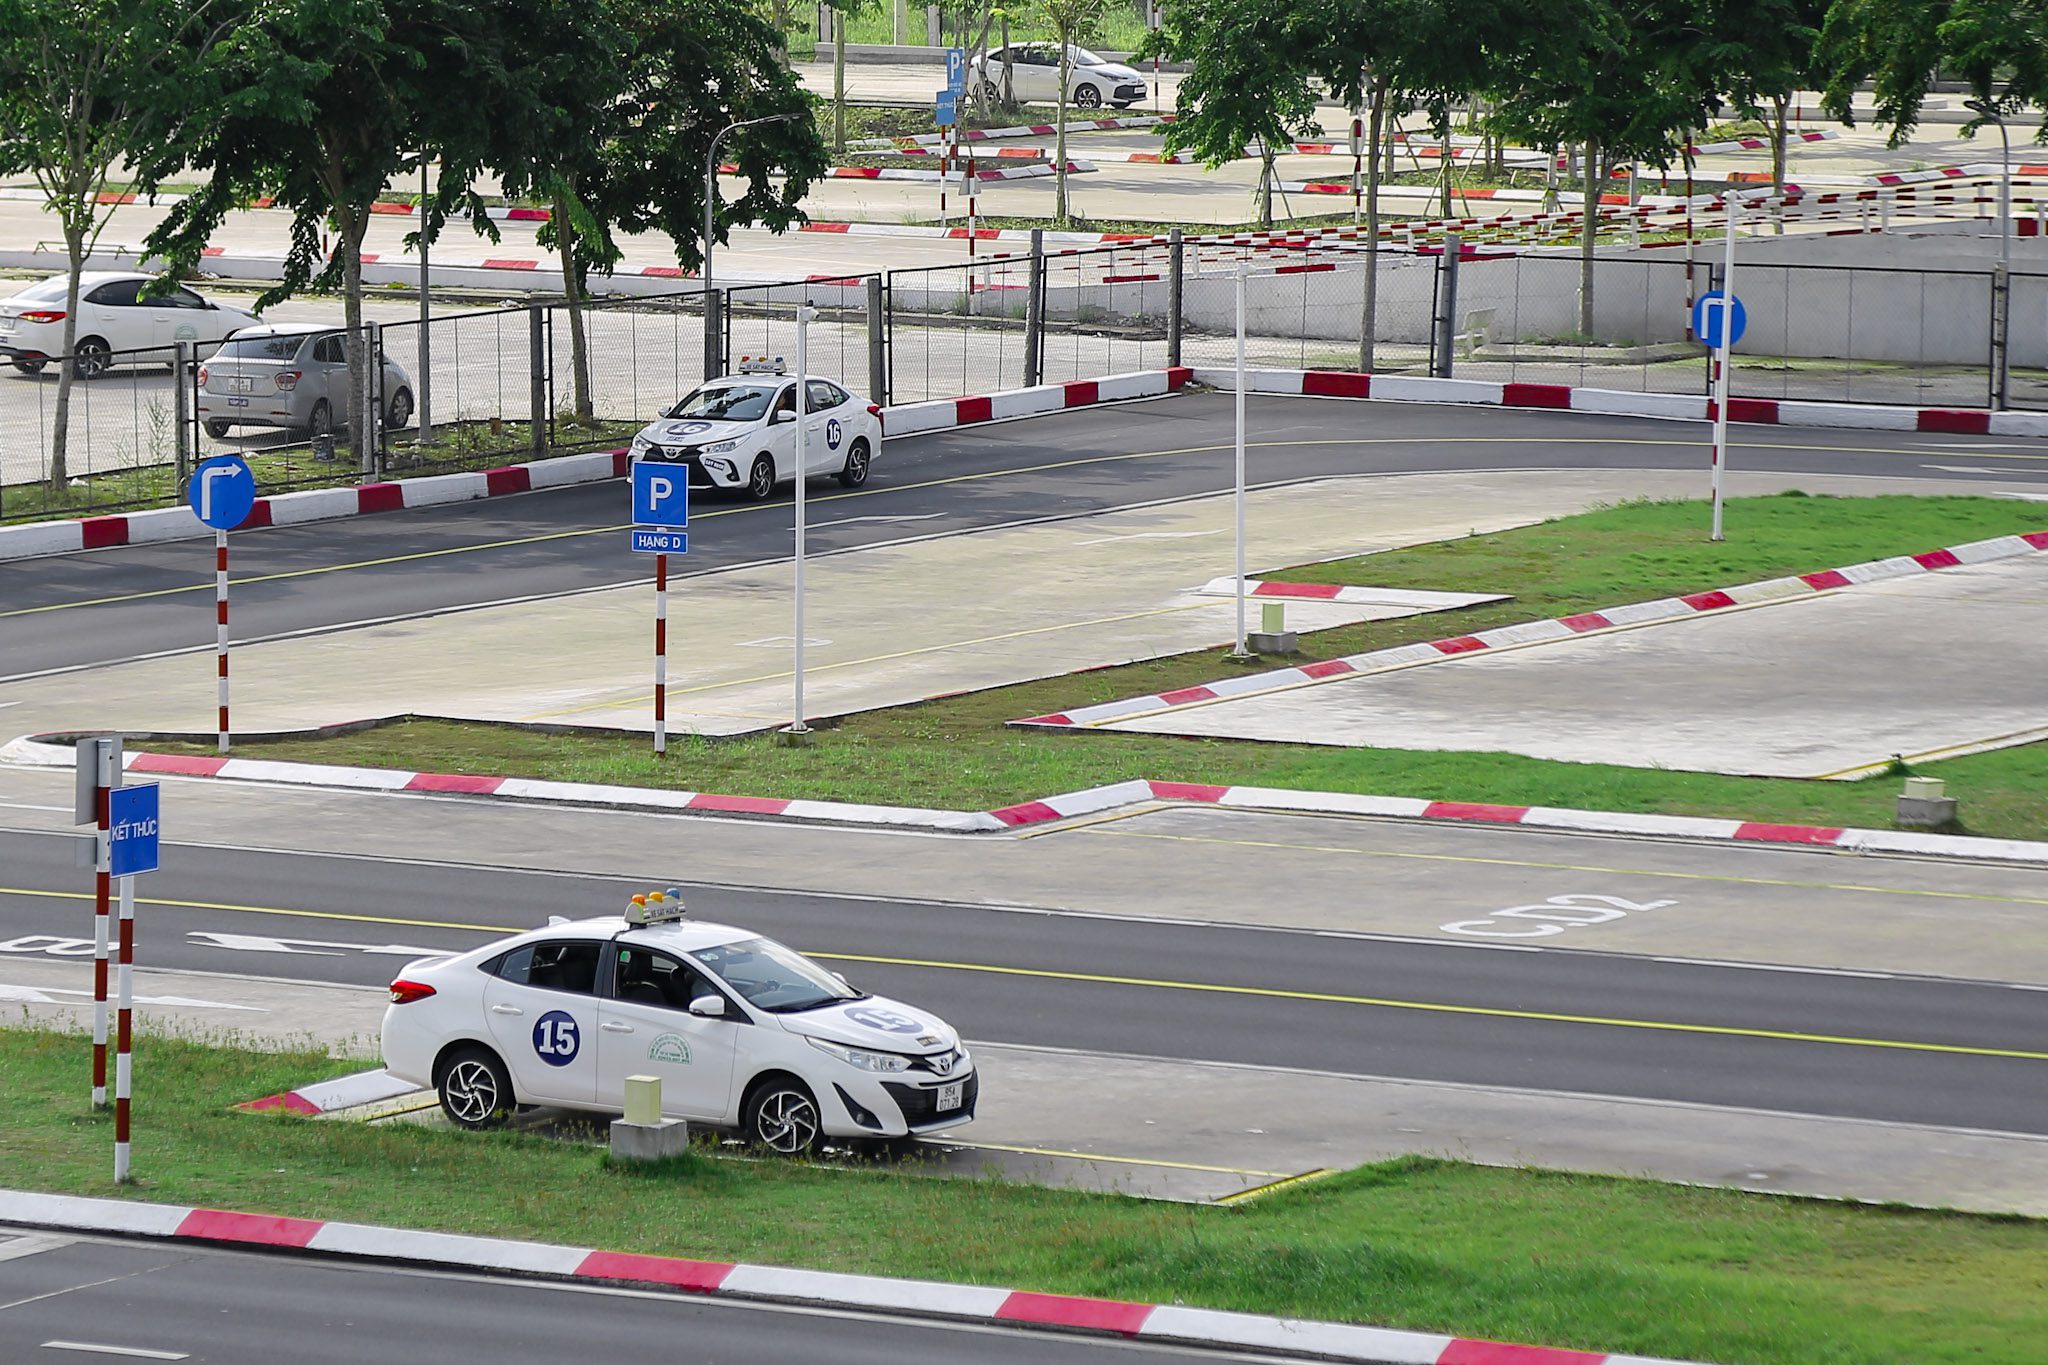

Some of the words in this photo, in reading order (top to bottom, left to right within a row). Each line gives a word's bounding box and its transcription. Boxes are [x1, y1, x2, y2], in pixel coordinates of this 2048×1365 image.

[951, 52, 960, 79] P
[668, 423, 707, 433] 16
[829, 423, 840, 443] 16
[650, 477, 673, 511] P
[639, 535, 668, 549] HẠNG
[673, 537, 681, 549] D
[112, 818, 130, 841] KẾT
[132, 816, 157, 838] THÚC
[854, 1010, 915, 1031] 15
[539, 1020, 575, 1055] 15
